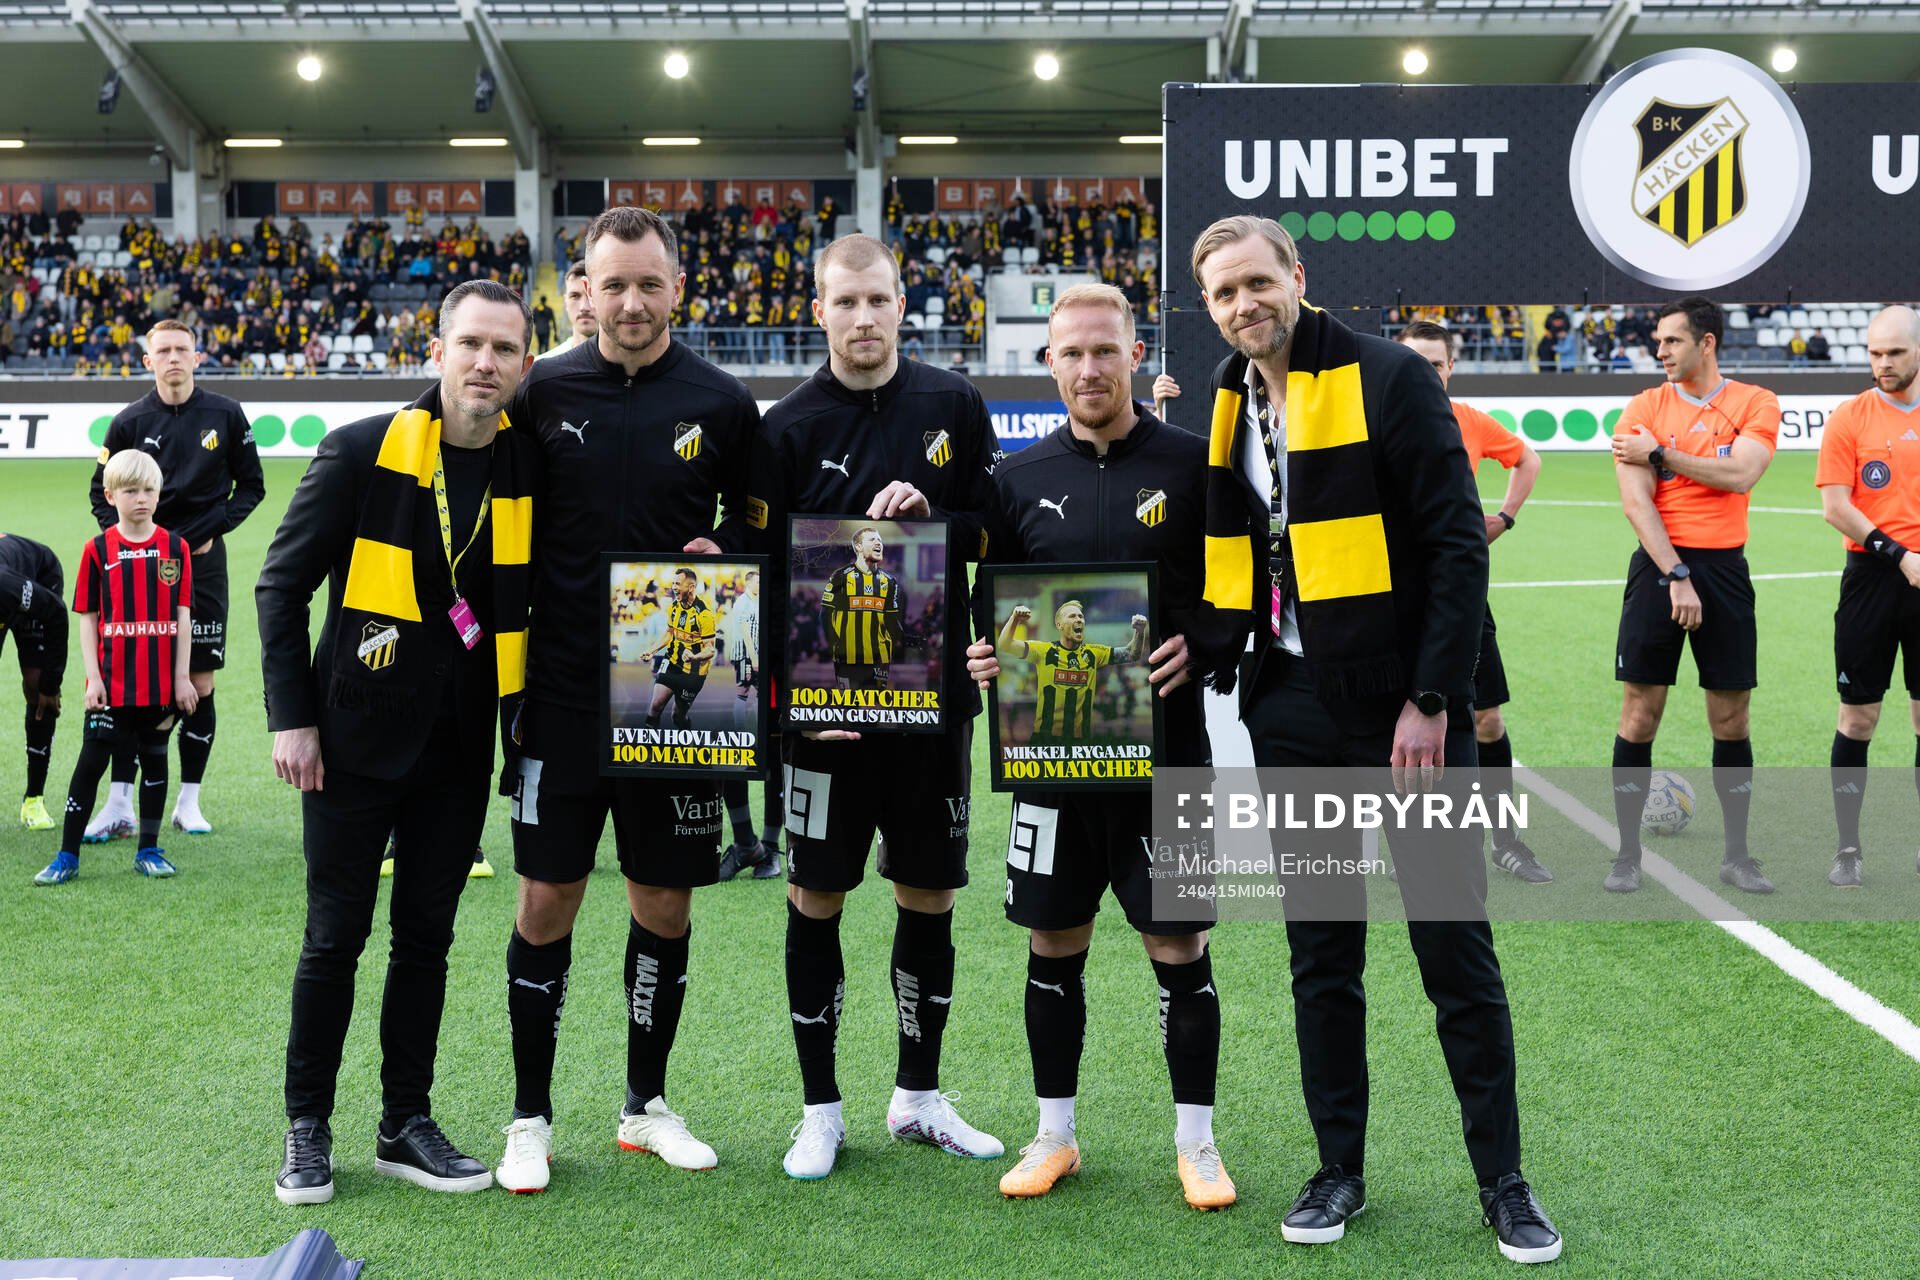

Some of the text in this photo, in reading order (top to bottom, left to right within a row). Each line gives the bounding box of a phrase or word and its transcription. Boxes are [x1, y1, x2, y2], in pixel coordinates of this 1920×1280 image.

[1643, 114, 1734, 197] HÄCKEN
[1872, 135, 1920, 195] U
[1224, 137, 1508, 200] UNIBET
[286, 188, 369, 205] BRA
[394, 188, 478, 205] BRA
[1781, 409, 1833, 438] SP
[117, 548, 160, 560] stadium
[852, 599, 883, 608] BRA
[103, 622, 178, 637] BAUHAUS
[1057, 673, 1087, 682] BRA
[790, 687, 940, 708] 100 MATCHER
[789, 707, 940, 725] SIMON GUSTAFSON
[612, 727, 756, 748] EVEN HOVLAND
[611, 744, 757, 767] 100 MATCHER
[1003, 744, 1151, 760] MIKKEL RYGAARD
[1002, 759, 1153, 779] 100 MATCHER
[1644, 811, 1677, 823] SELECT
[633, 952, 659, 1027] MAXXIS
[896, 967, 921, 1040] MAXXIS
